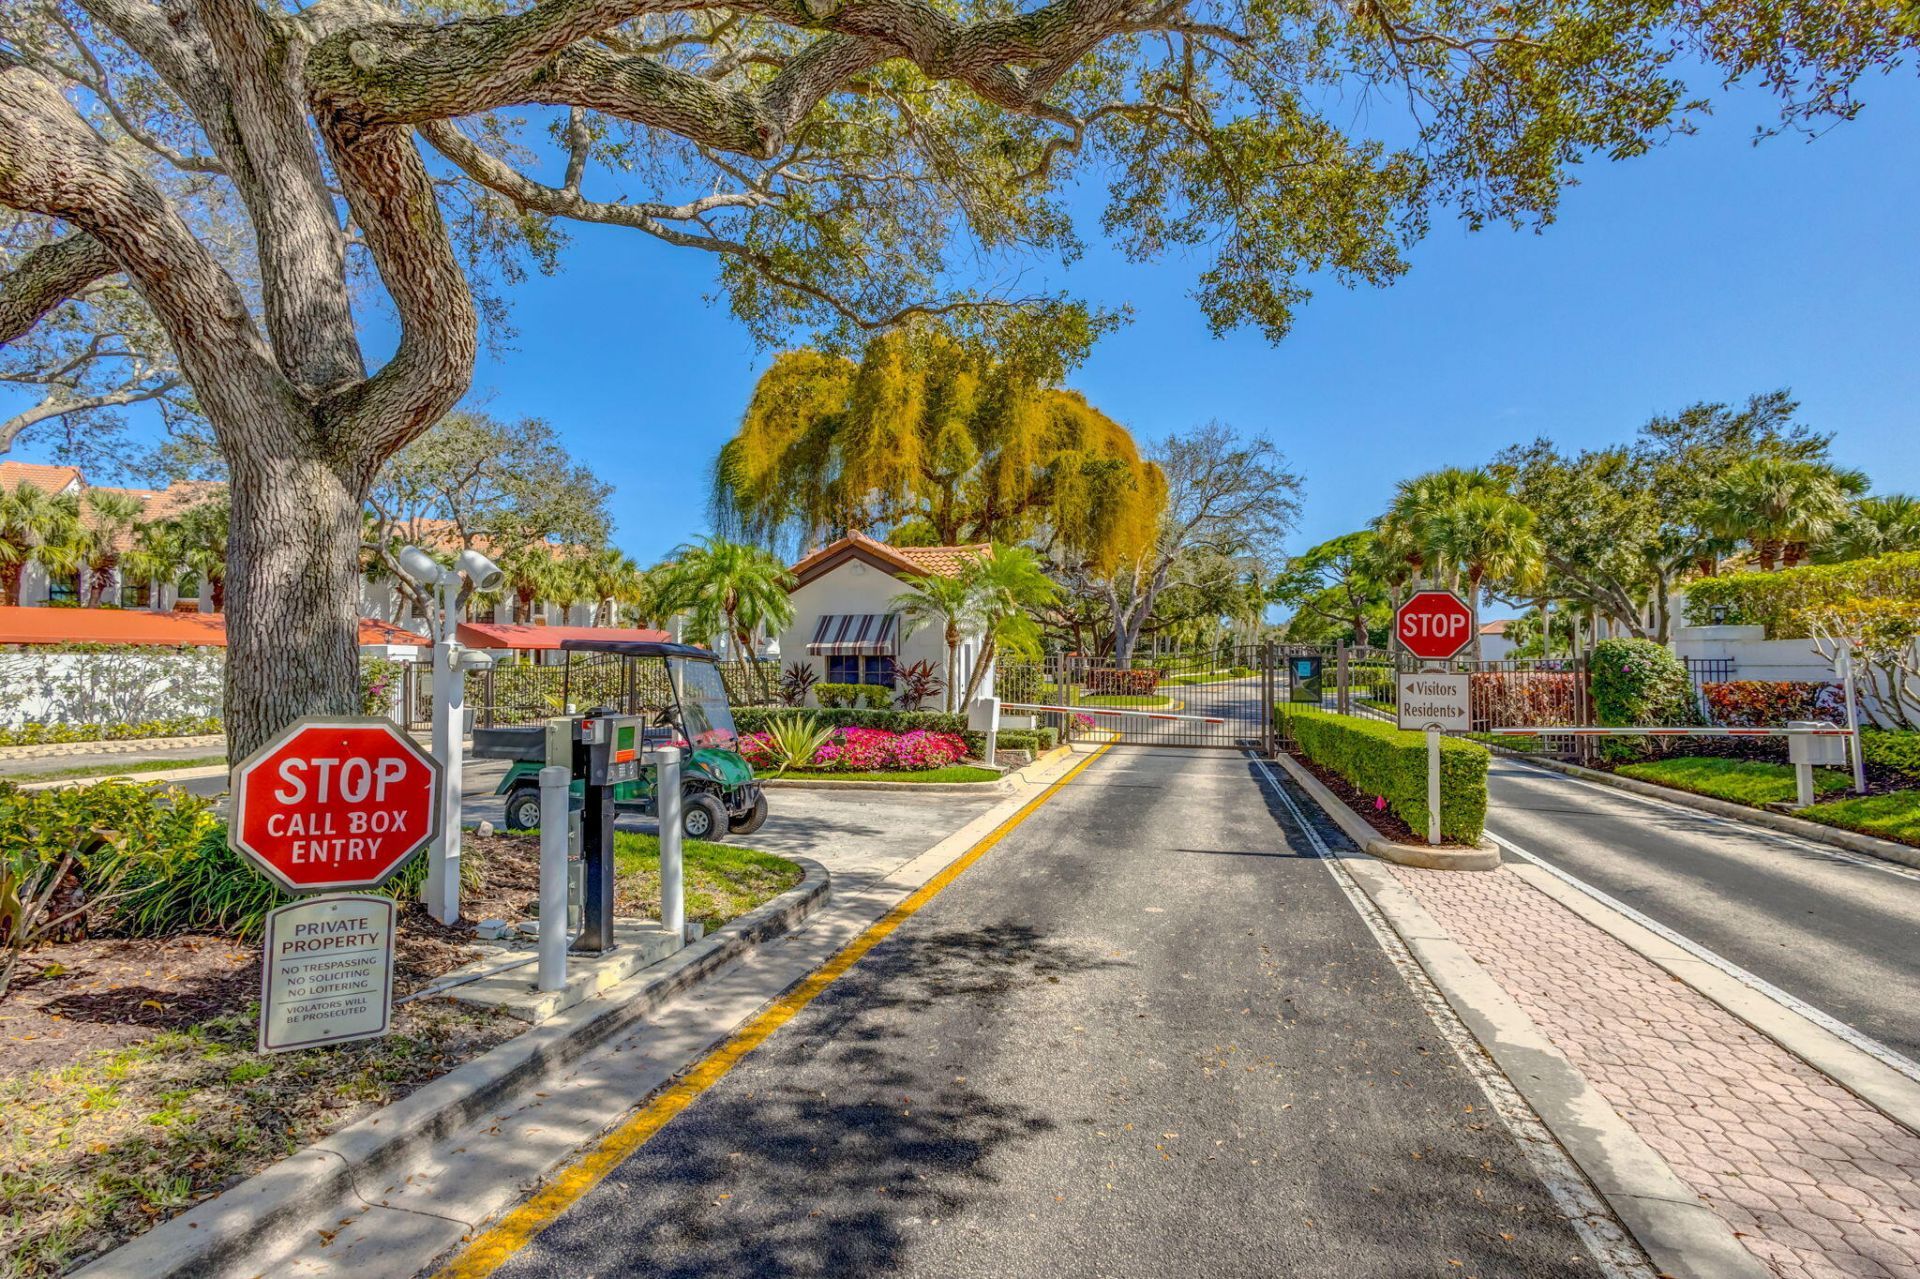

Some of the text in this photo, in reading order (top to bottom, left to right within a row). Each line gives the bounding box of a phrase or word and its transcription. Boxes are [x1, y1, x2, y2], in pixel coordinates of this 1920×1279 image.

[1402, 613, 1466, 638] STOP
[1416, 681, 1457, 696] Visitors
[1404, 702, 1456, 718] Residents
[274, 757, 407, 805] STOP
[267, 810, 408, 837] CALL BOX
[292, 837, 382, 863] ENTRY
[295, 918, 368, 936] PRIVATE
[282, 932, 379, 954] PROPERTY
[281, 957, 377, 975] NO TRESPASSING
[287, 968, 370, 986] NO SOLICITING
[288, 980, 368, 997] NO LOITERING
[287, 997, 367, 1014] VIOLATORS WILL
[287, 1006, 367, 1024] BE PROSECUTED
